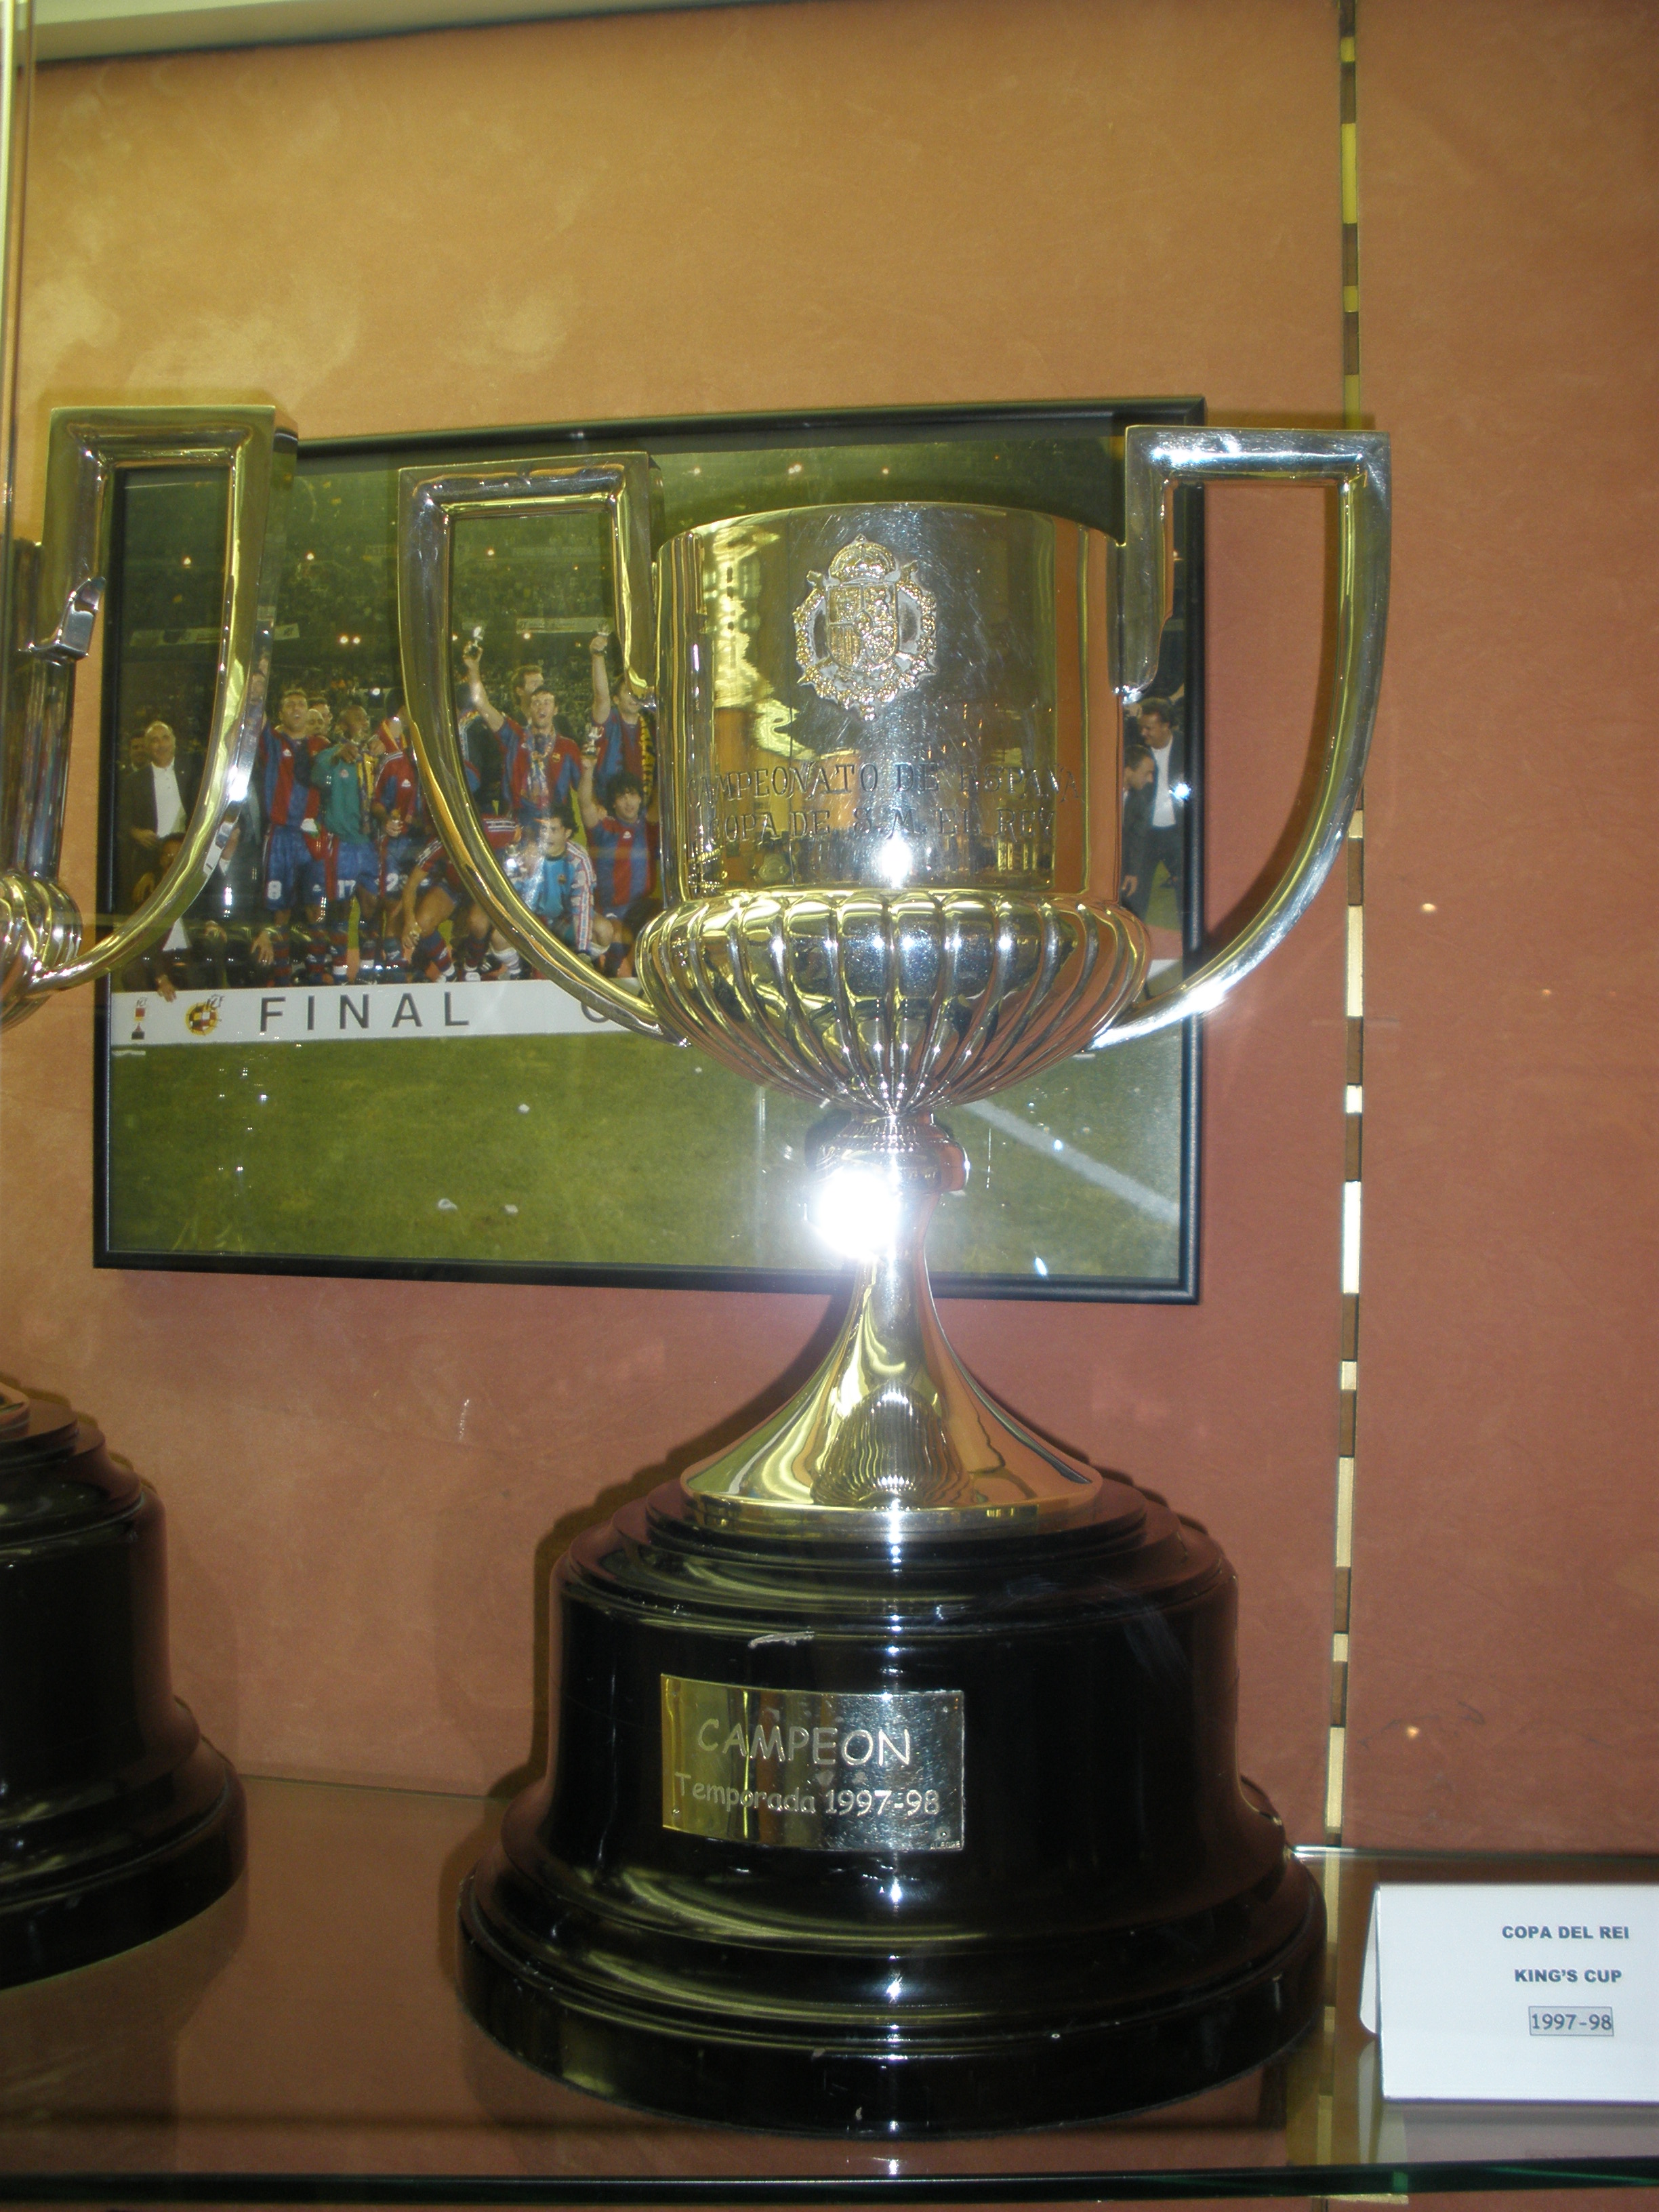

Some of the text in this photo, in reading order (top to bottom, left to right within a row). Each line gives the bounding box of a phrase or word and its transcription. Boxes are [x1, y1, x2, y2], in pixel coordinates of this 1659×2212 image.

[893, 762, 940, 794] DE
[710, 811, 782, 846] COPA
[788, 809, 831, 838] DE
[267, 880, 282, 900] 8
[259, 991, 470, 1033] FINAL
[697, 1718, 911, 1766] CAMPEON
[675, 1771, 941, 1816] Temporada 1997-98
[1502, 1925, 1630, 1940] COPA DEL REI
[1514, 1969, 1622, 1983] KING'S CUP
[1531, 2013, 1613, 2031] 1997-98
